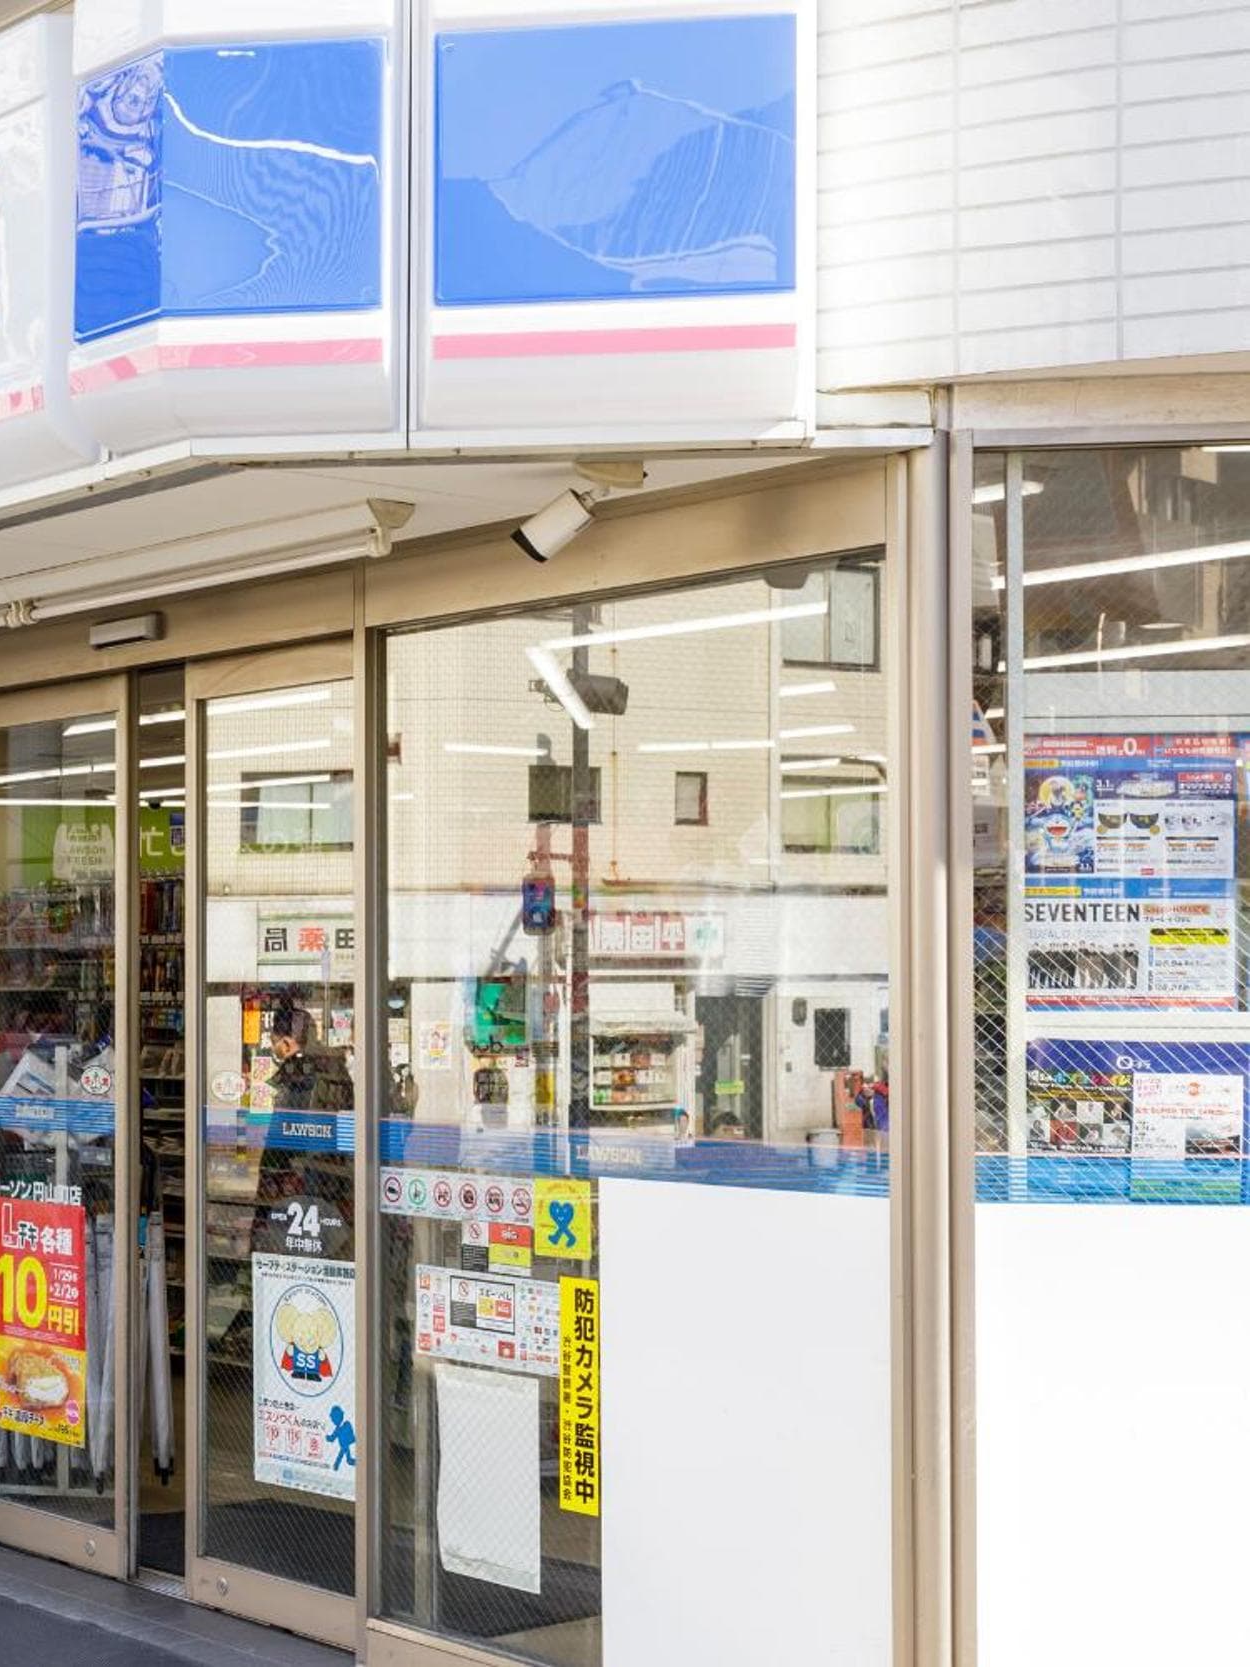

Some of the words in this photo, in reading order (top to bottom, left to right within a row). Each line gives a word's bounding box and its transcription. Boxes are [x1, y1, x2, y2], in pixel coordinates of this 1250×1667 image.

[1023, 903, 1140, 922] SEVENTEEN
[282, 1121, 333, 1139] LAWSON
[287, 1202, 321, 1237] 24
[296, 1352, 316, 1370] SS
[573, 1287, 595, 1505] 防犯カメラ監視中
